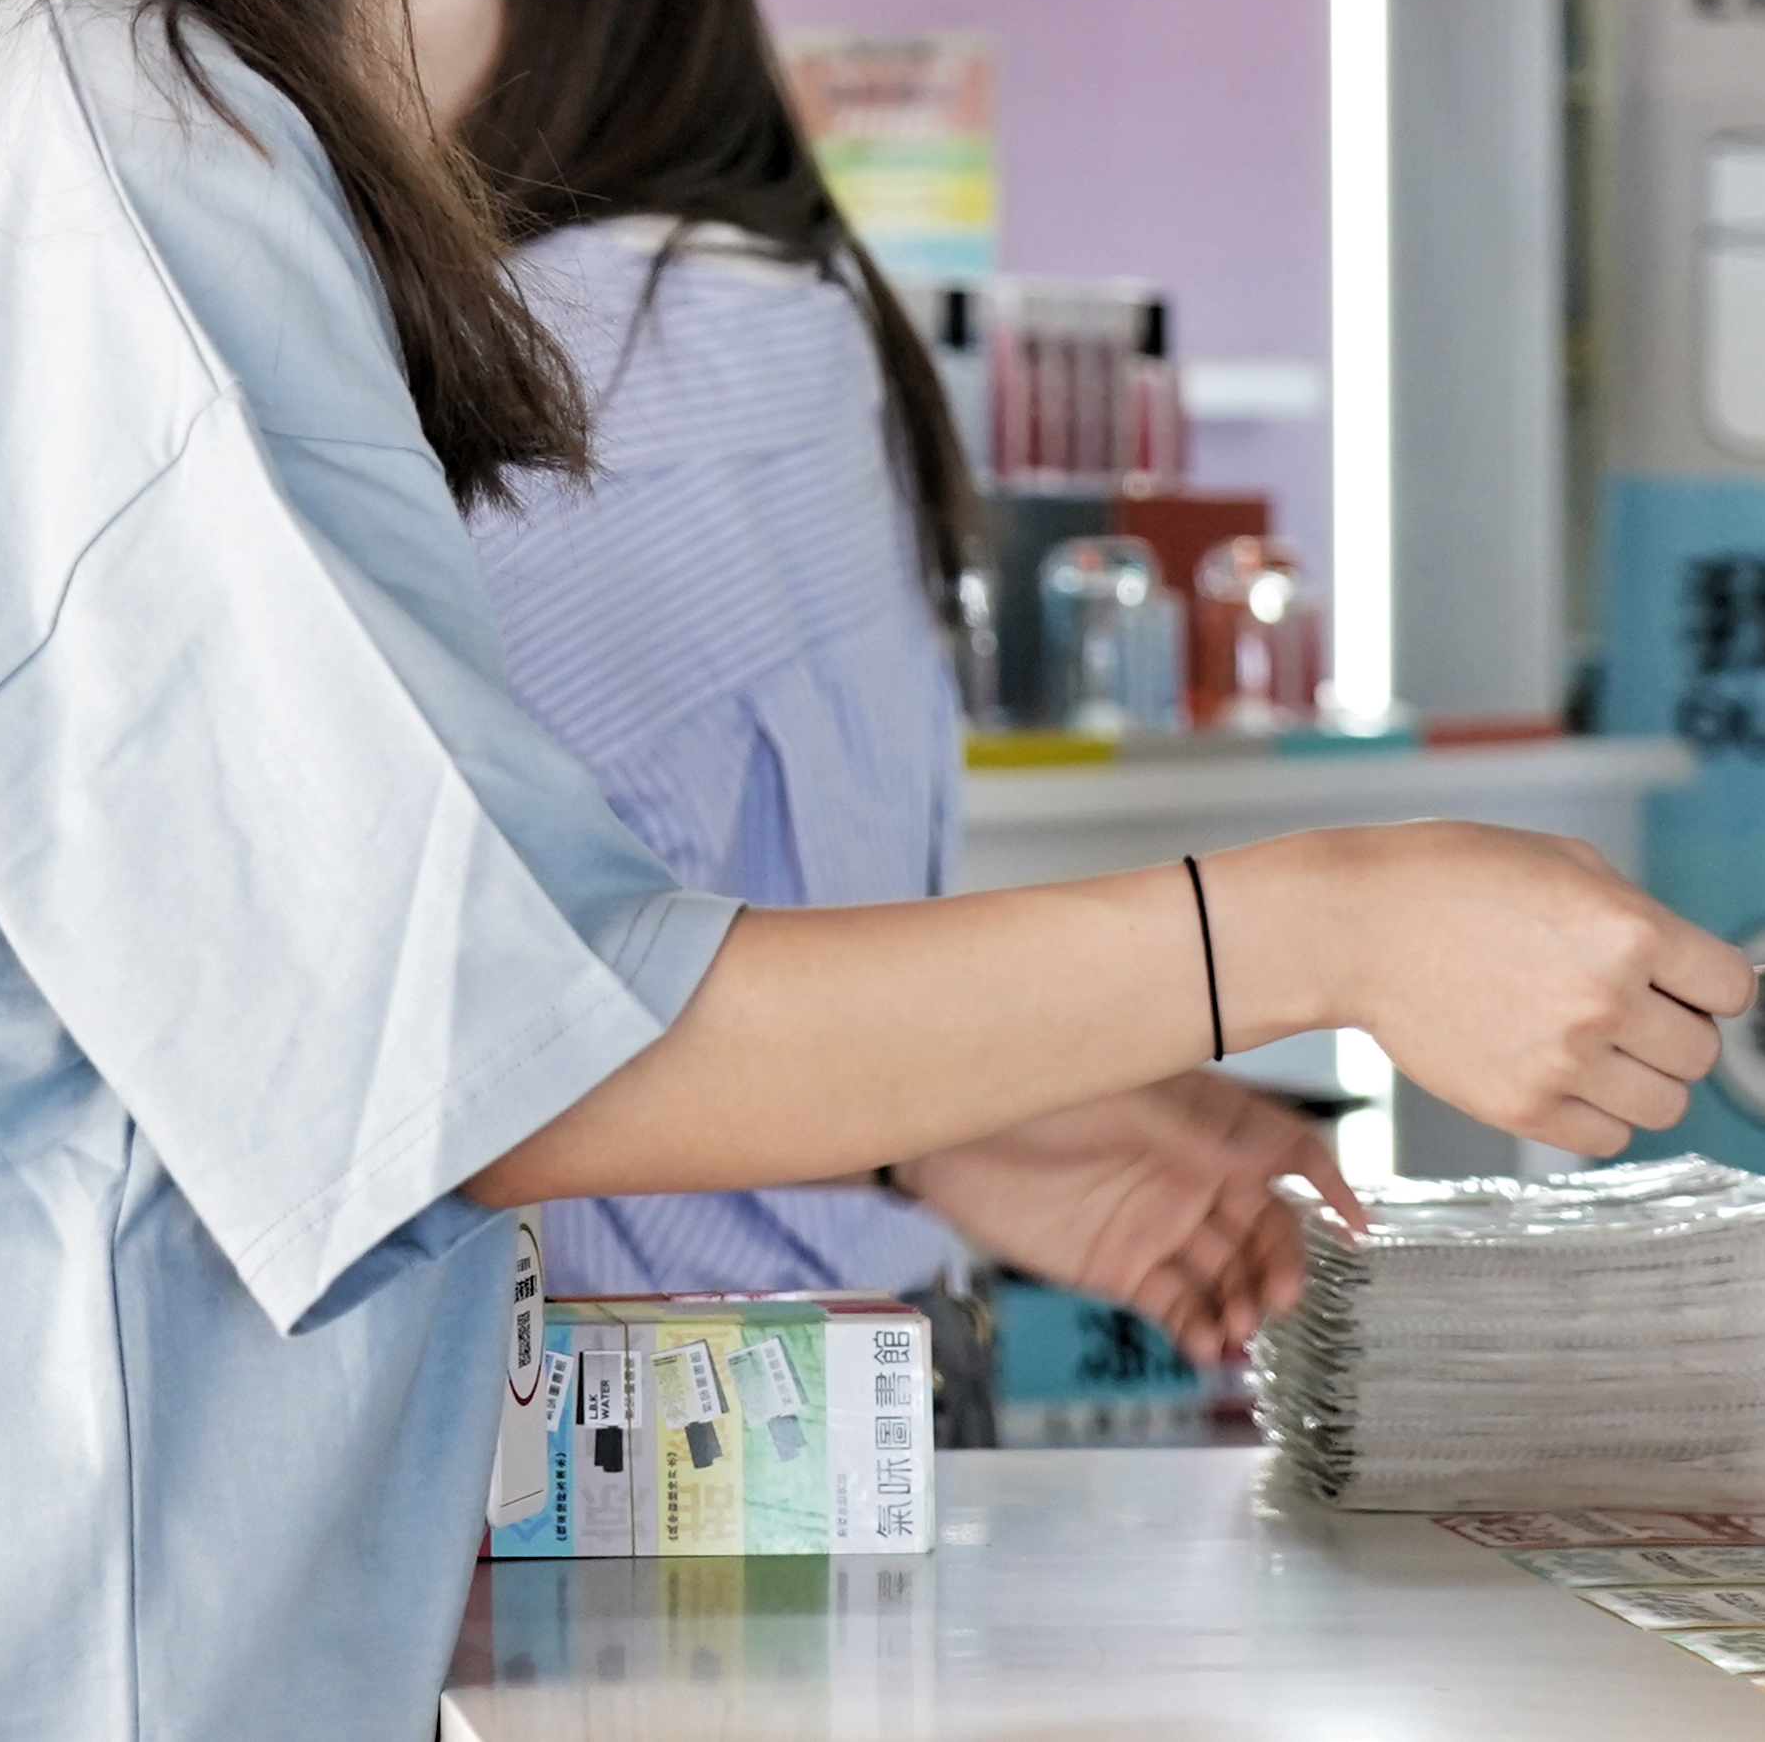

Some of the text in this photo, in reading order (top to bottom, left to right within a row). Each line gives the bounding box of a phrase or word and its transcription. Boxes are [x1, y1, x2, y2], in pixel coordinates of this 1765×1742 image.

[600, 1378, 612, 1421] WATER
[872, 1329, 914, 1539] 氣味圖書館
